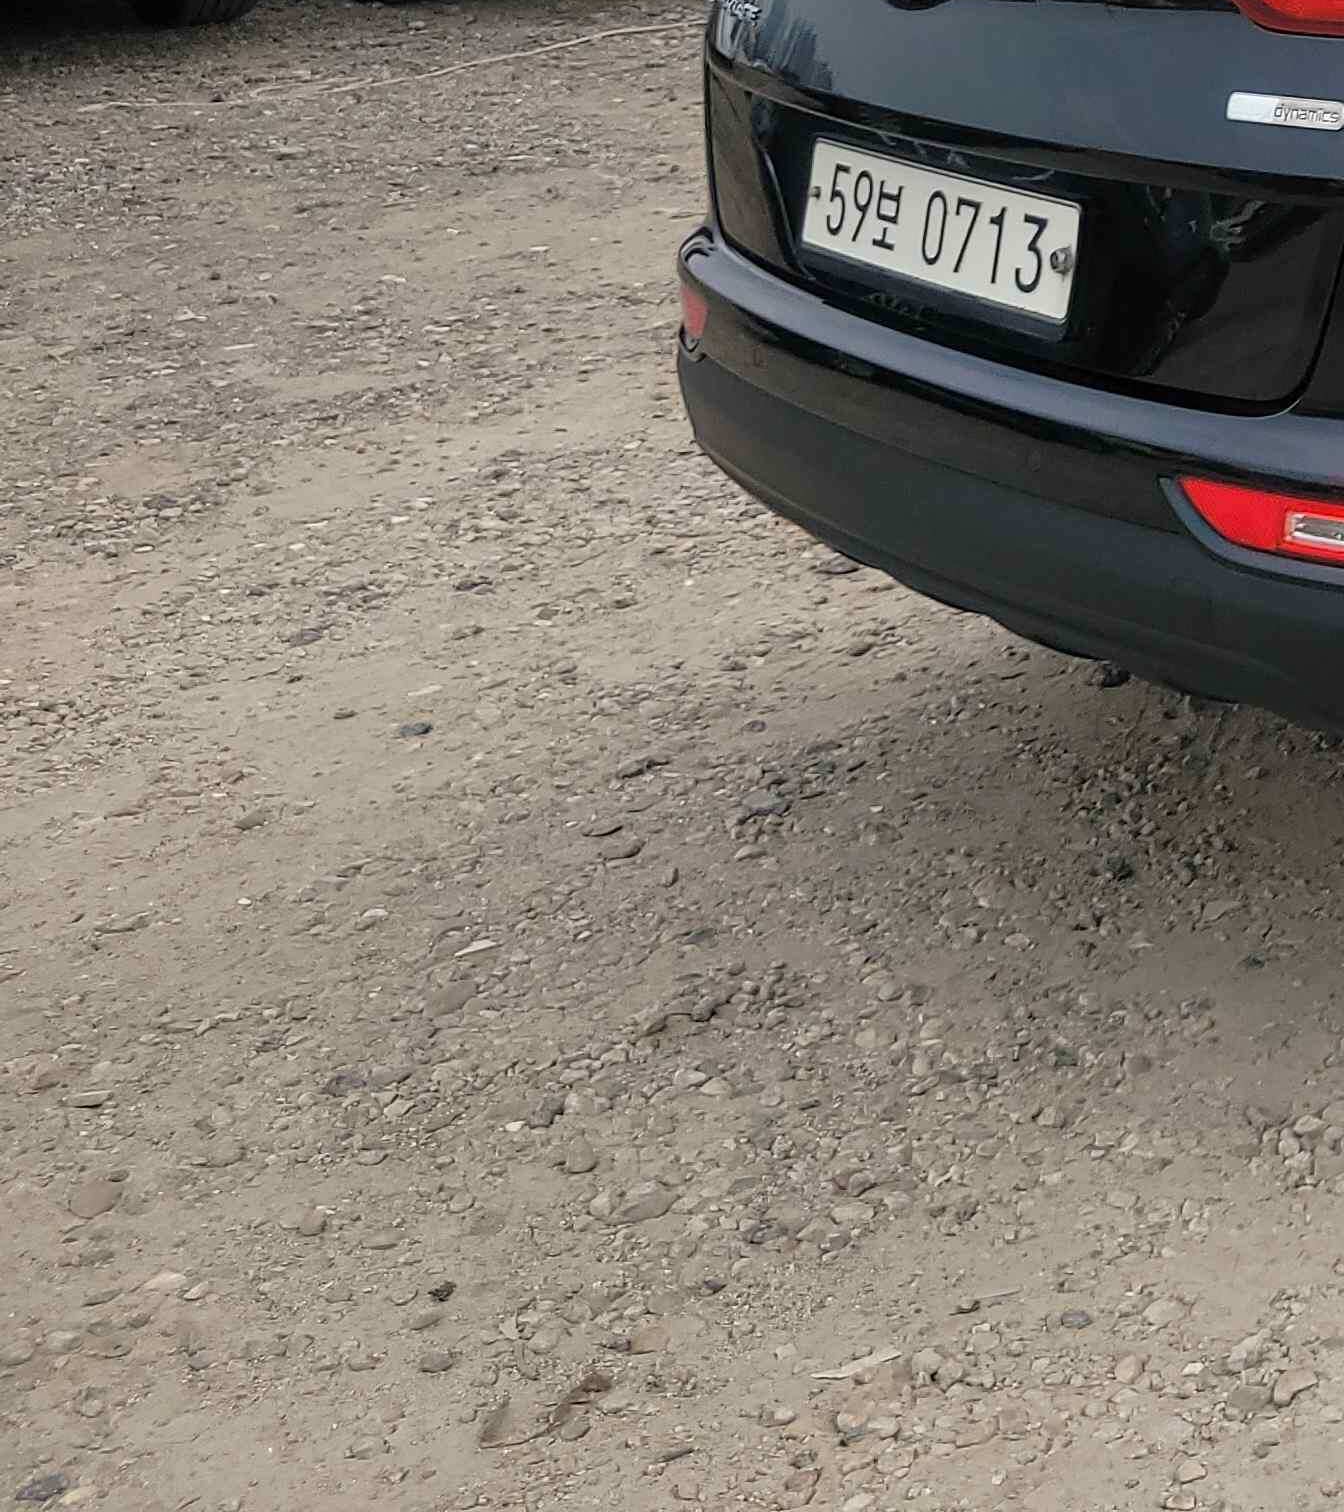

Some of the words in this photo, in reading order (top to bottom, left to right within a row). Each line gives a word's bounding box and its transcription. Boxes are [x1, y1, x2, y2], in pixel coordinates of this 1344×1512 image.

[1273, 101, 1343, 125] dynamics
[825, 162, 904, 251] 59보
[920, 189, 1049, 294] 0713
